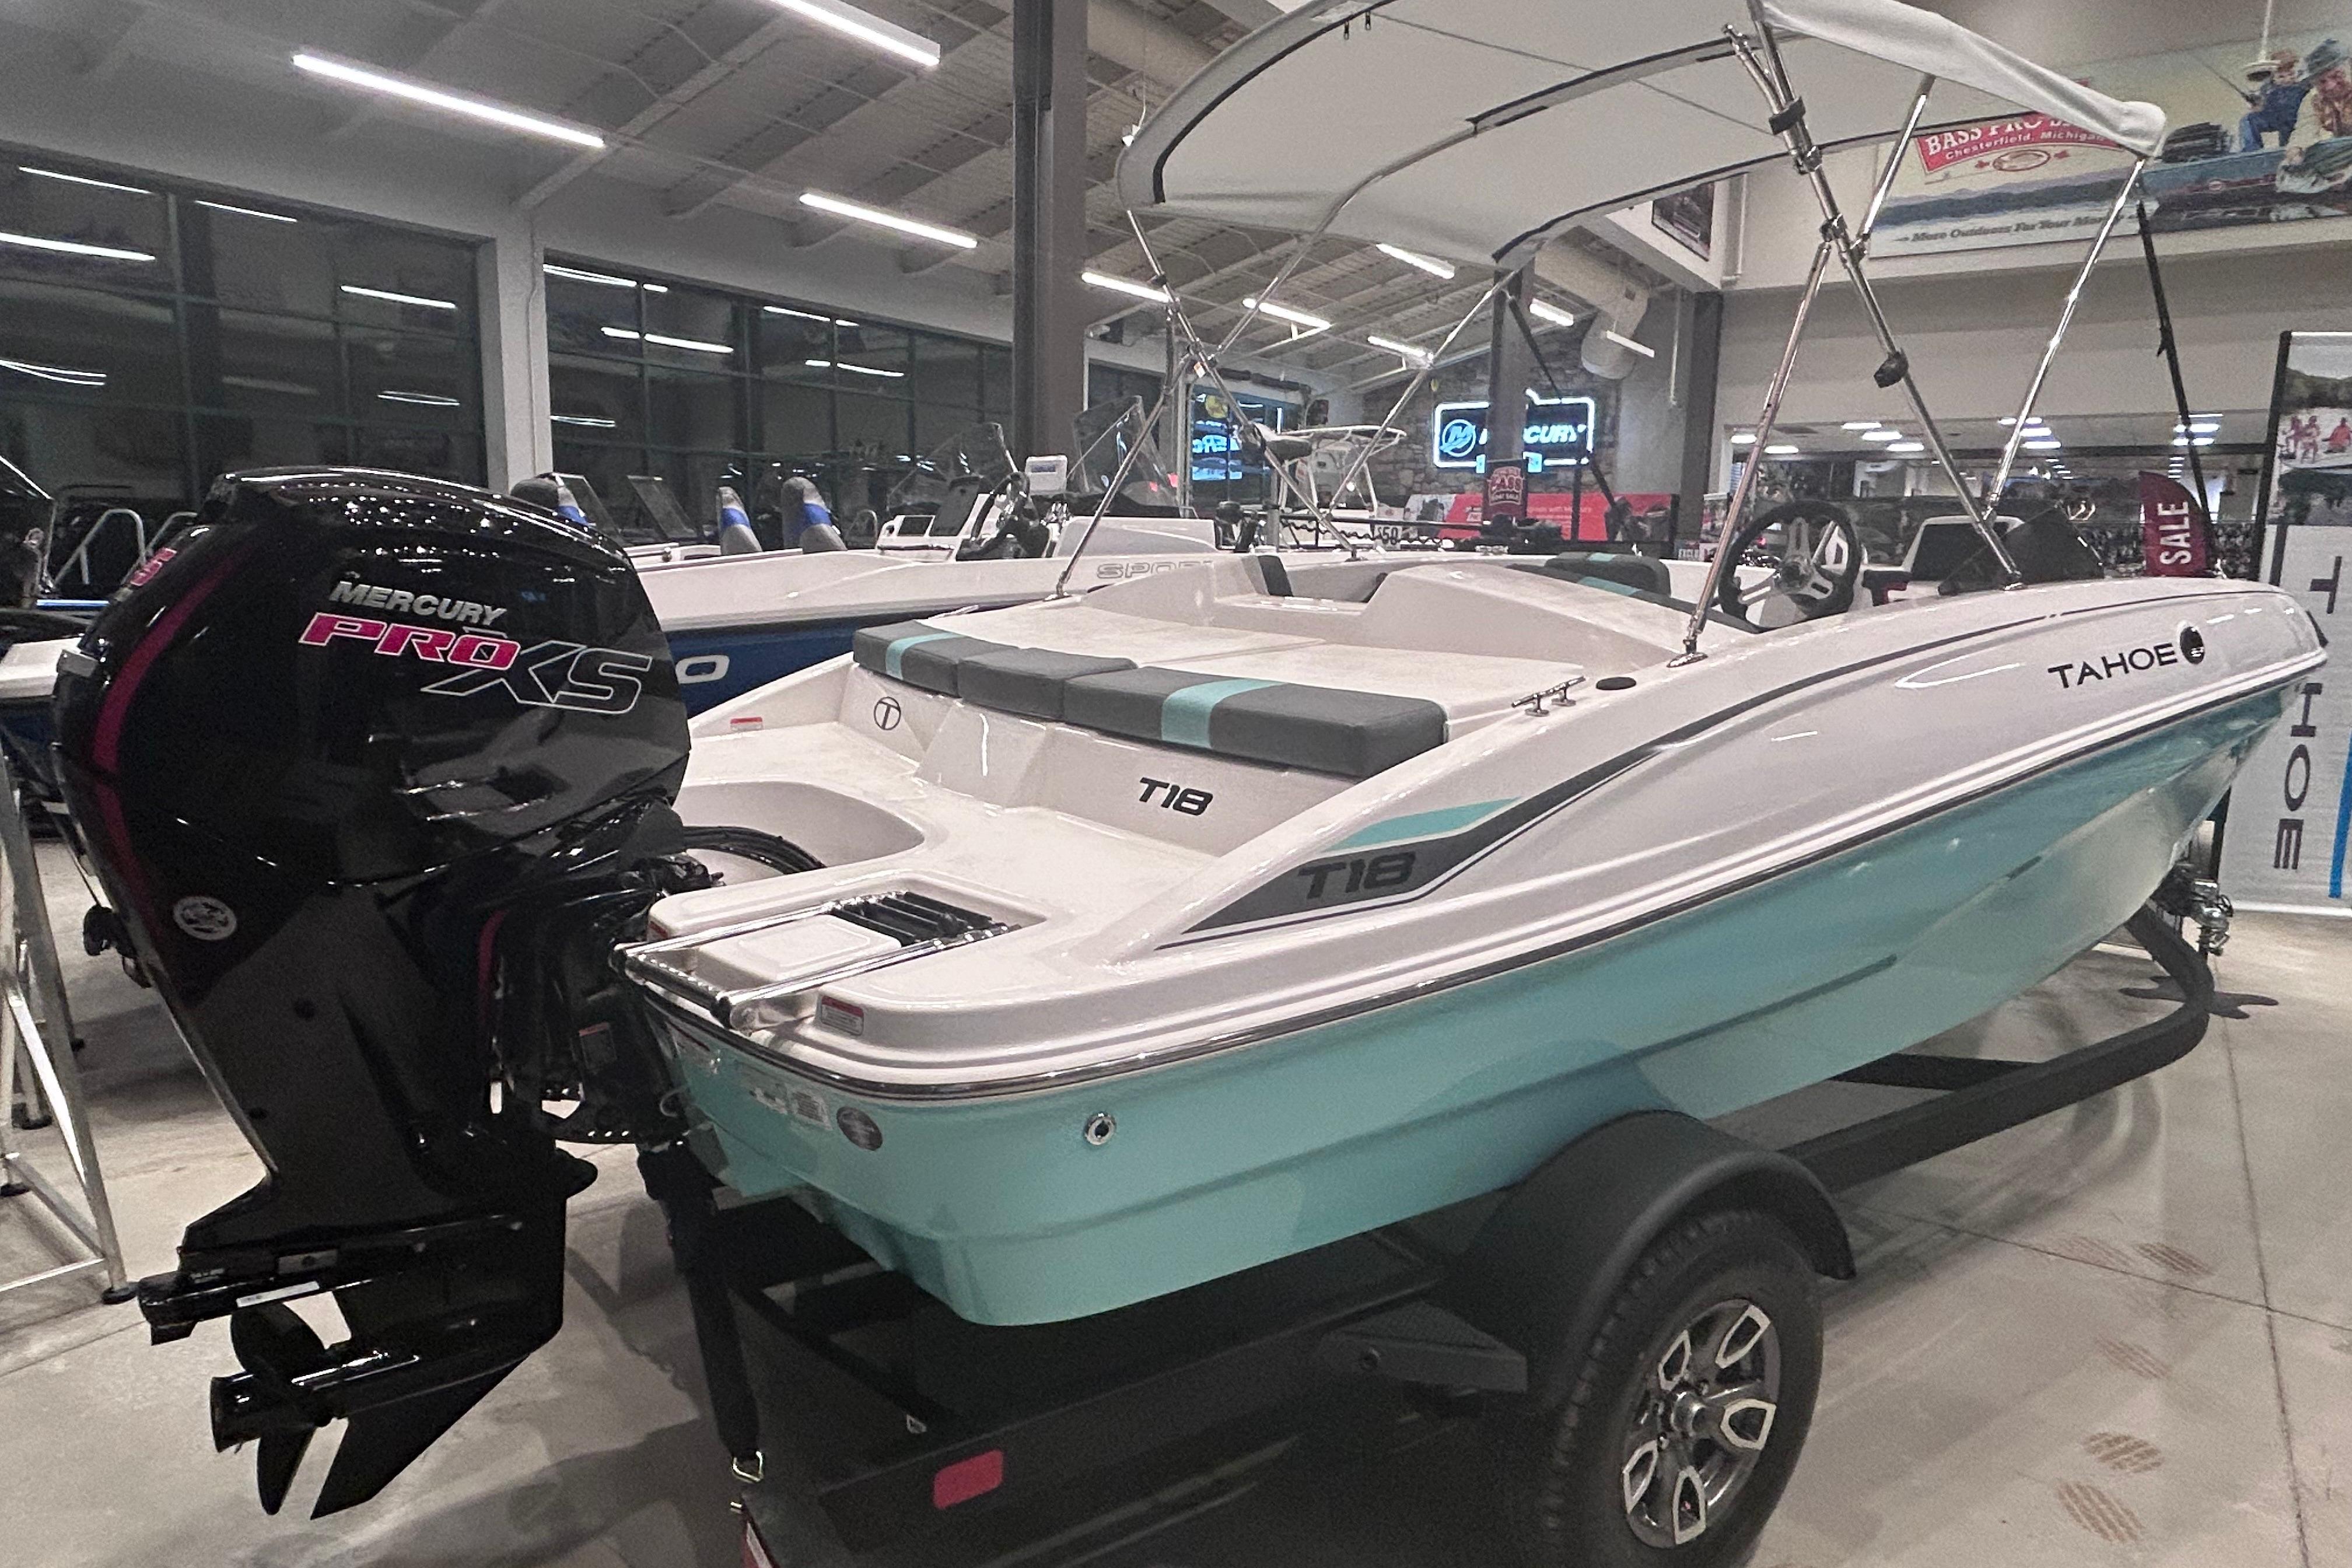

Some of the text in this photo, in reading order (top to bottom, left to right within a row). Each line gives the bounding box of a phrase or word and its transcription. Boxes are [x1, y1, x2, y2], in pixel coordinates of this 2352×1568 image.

[1925, 127, 1982, 155] BASS
[2157, 501, 2192, 565] SALE
[1097, 561, 1213, 579] SPO
[329, 581, 507, 625] MERCURY
[298, 612, 652, 715] PRO XS
[2048, 643, 2178, 688] TAHOE
[2274, 555, 2343, 870] THOE
[1139, 777, 1213, 816] T18
[1299, 851, 1416, 900] T18
